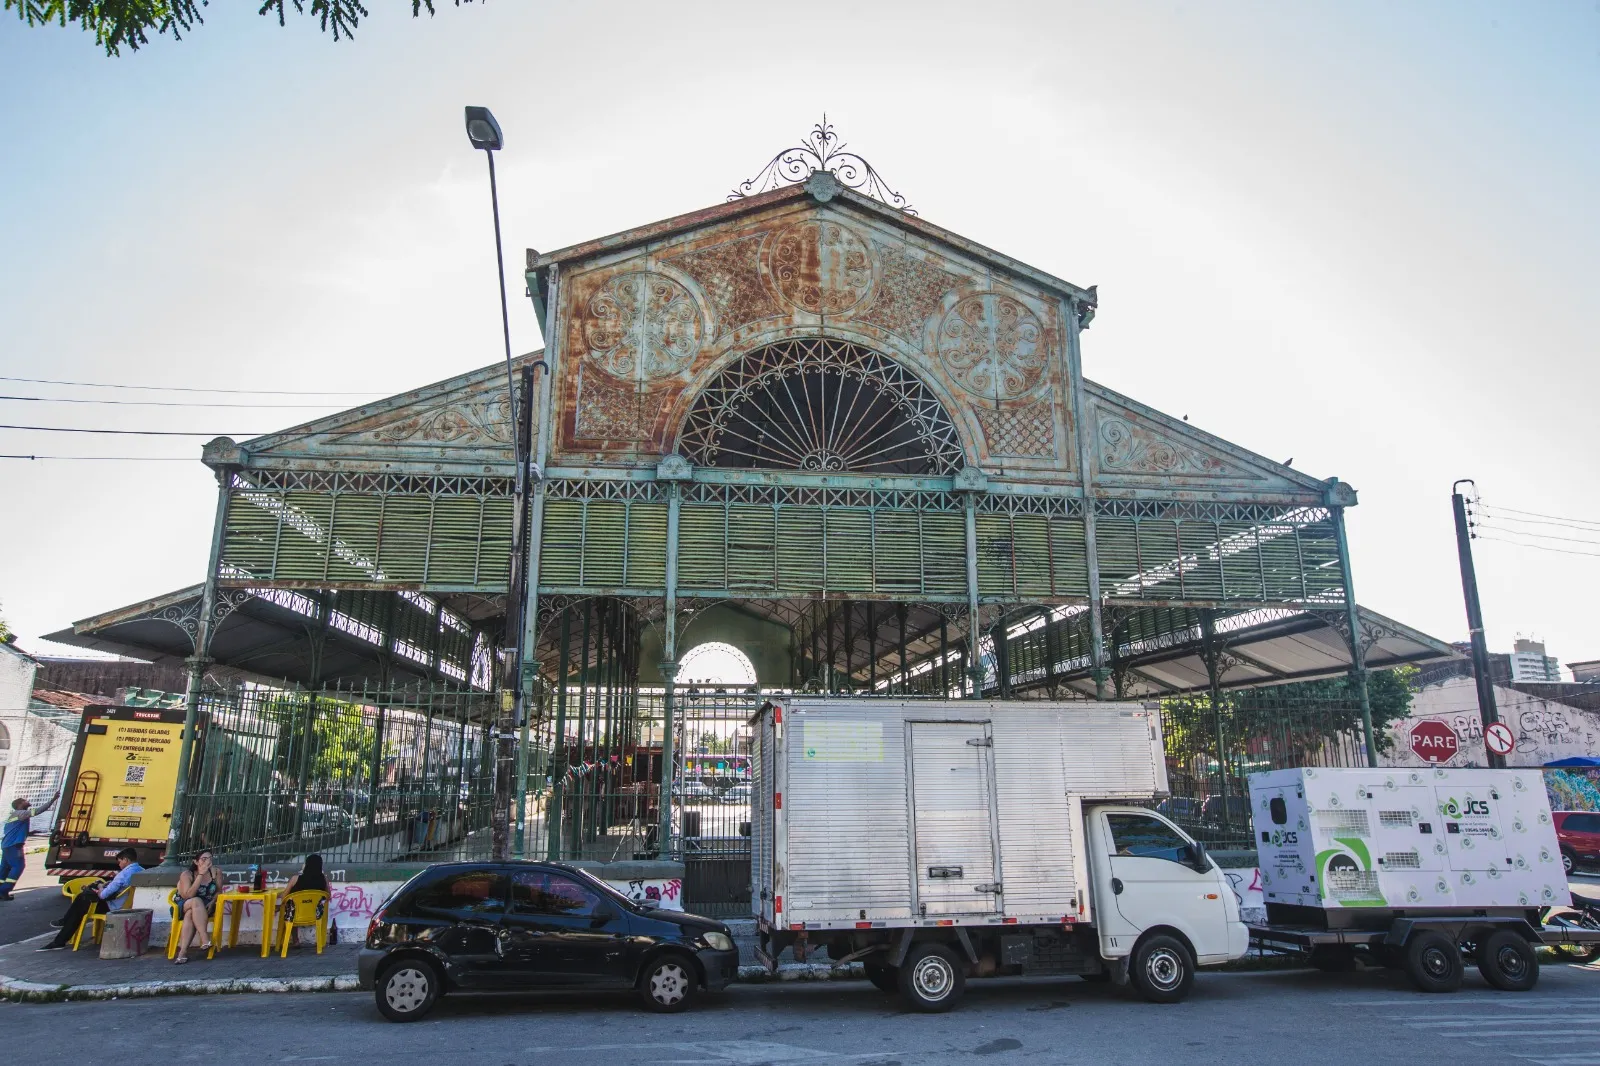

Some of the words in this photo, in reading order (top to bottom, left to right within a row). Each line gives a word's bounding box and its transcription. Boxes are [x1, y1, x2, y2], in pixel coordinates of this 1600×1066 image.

[1412, 735, 1456, 749] PARE
[1463, 801, 1490, 815] JCS
[1282, 832, 1298, 844] JCS
